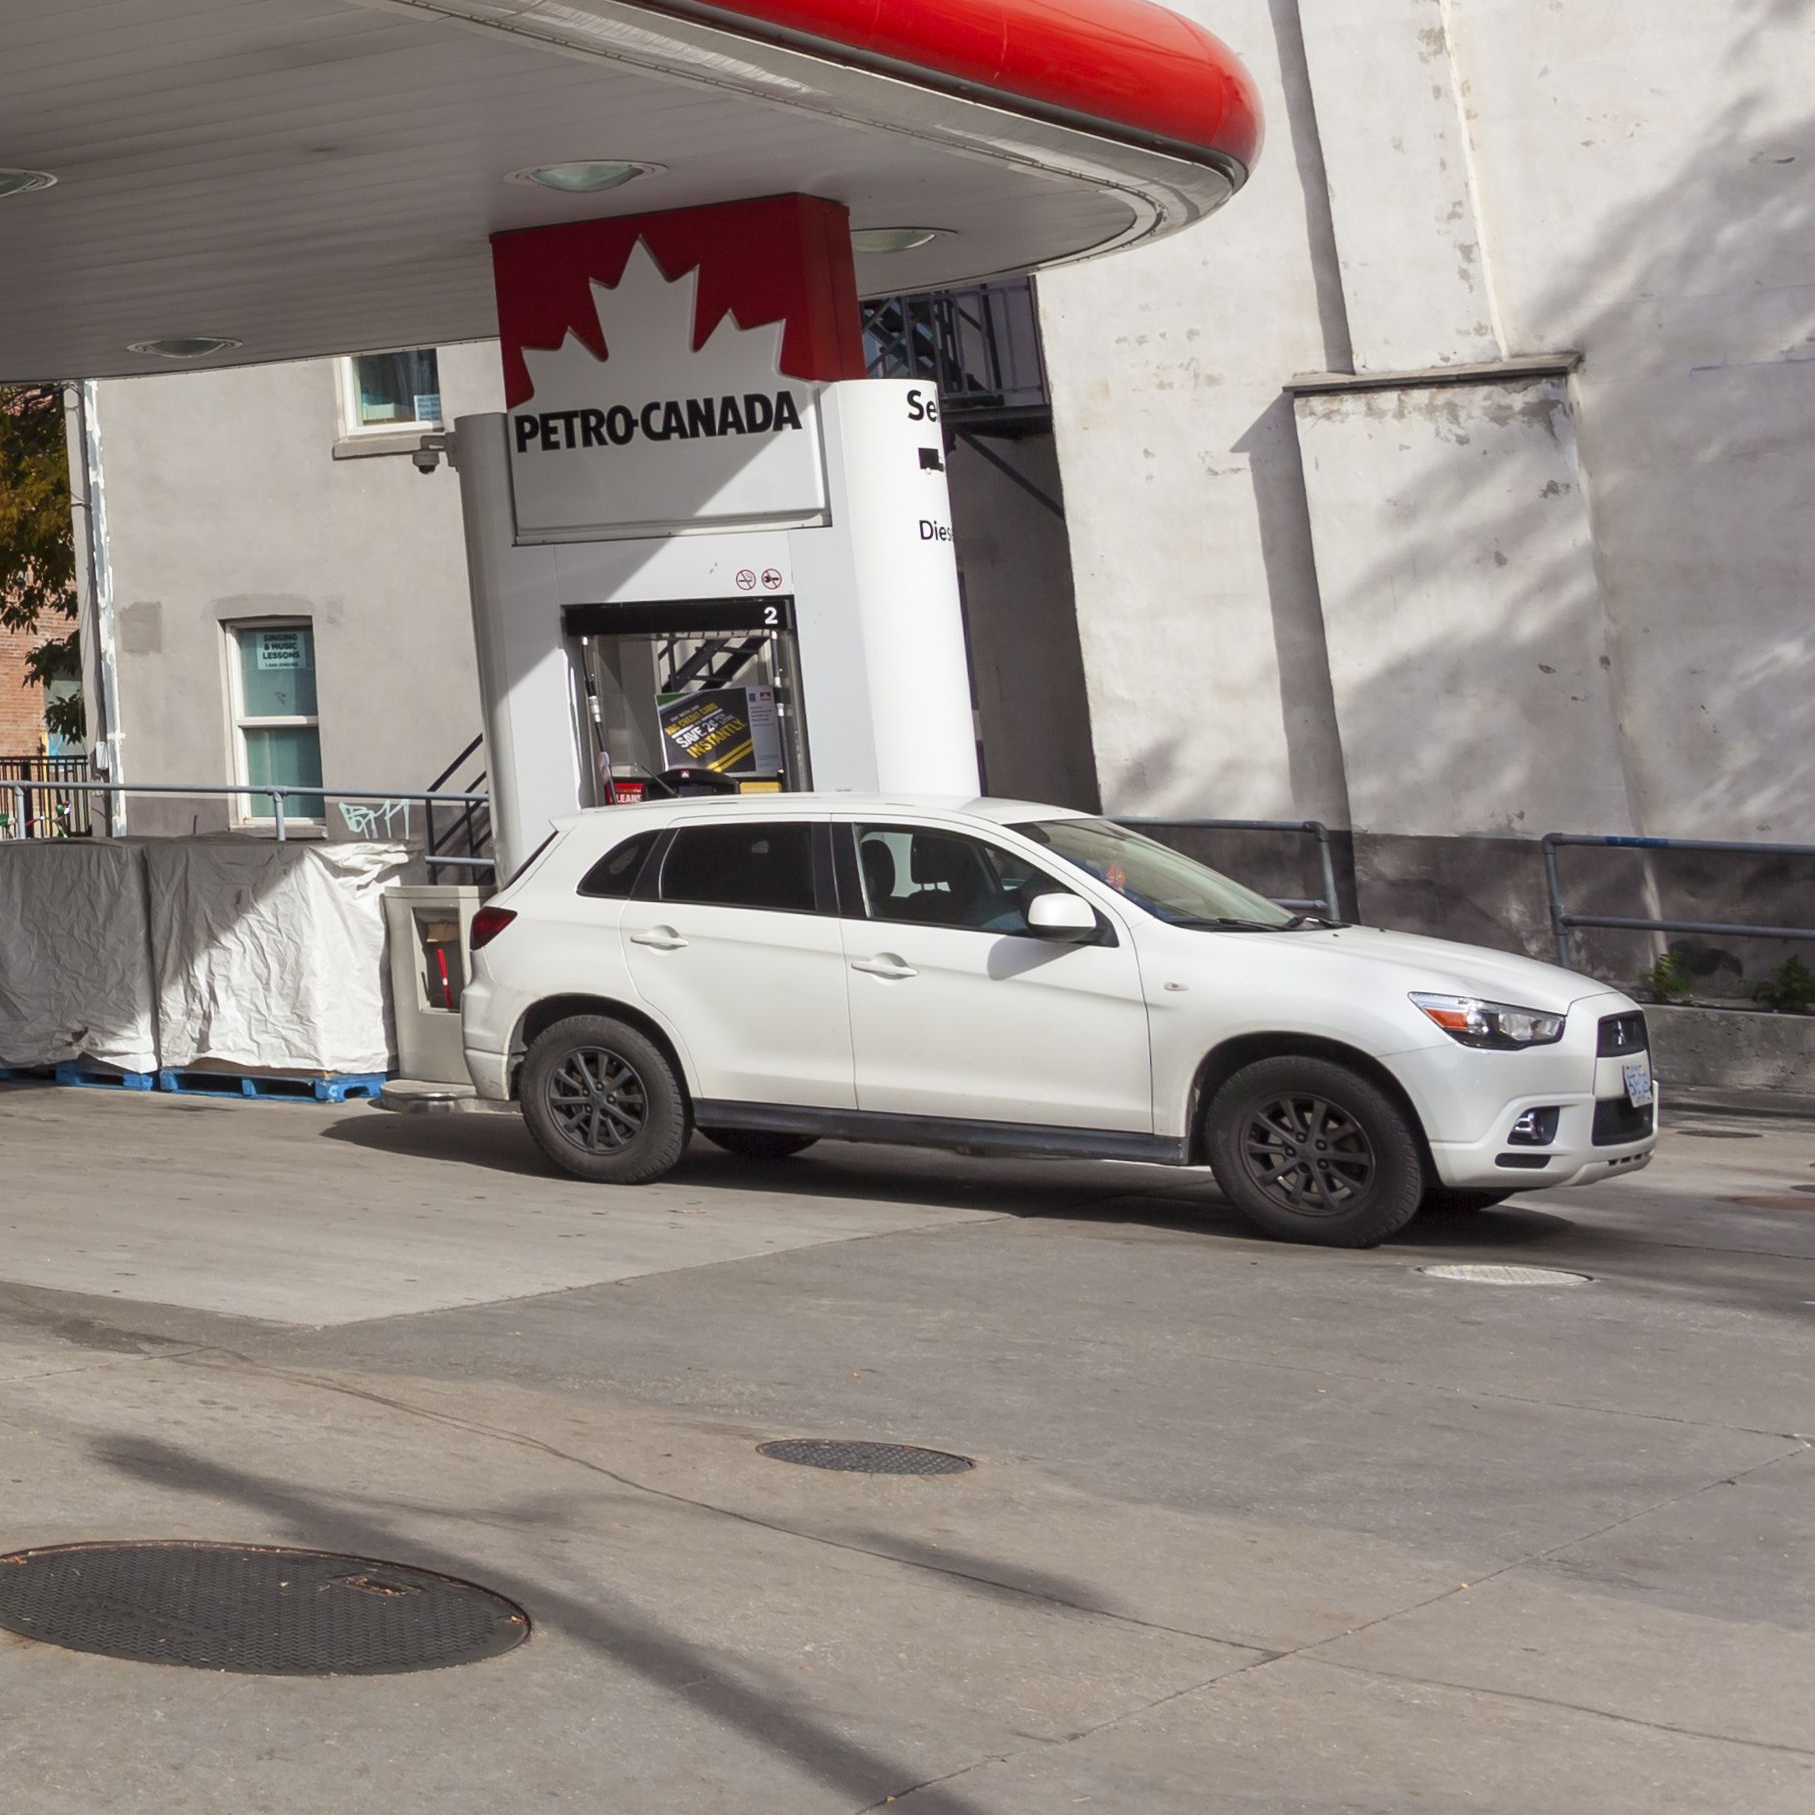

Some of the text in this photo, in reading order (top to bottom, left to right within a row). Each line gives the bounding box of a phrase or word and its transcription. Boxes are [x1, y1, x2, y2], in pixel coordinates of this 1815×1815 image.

[764, 607, 779, 625] 2
[271, 642, 298, 650] MUSIC
[262, 651, 301, 660] LESSONS
[675, 726, 706, 748] SAVE
[686, 717, 747, 758] INSTANTLY
